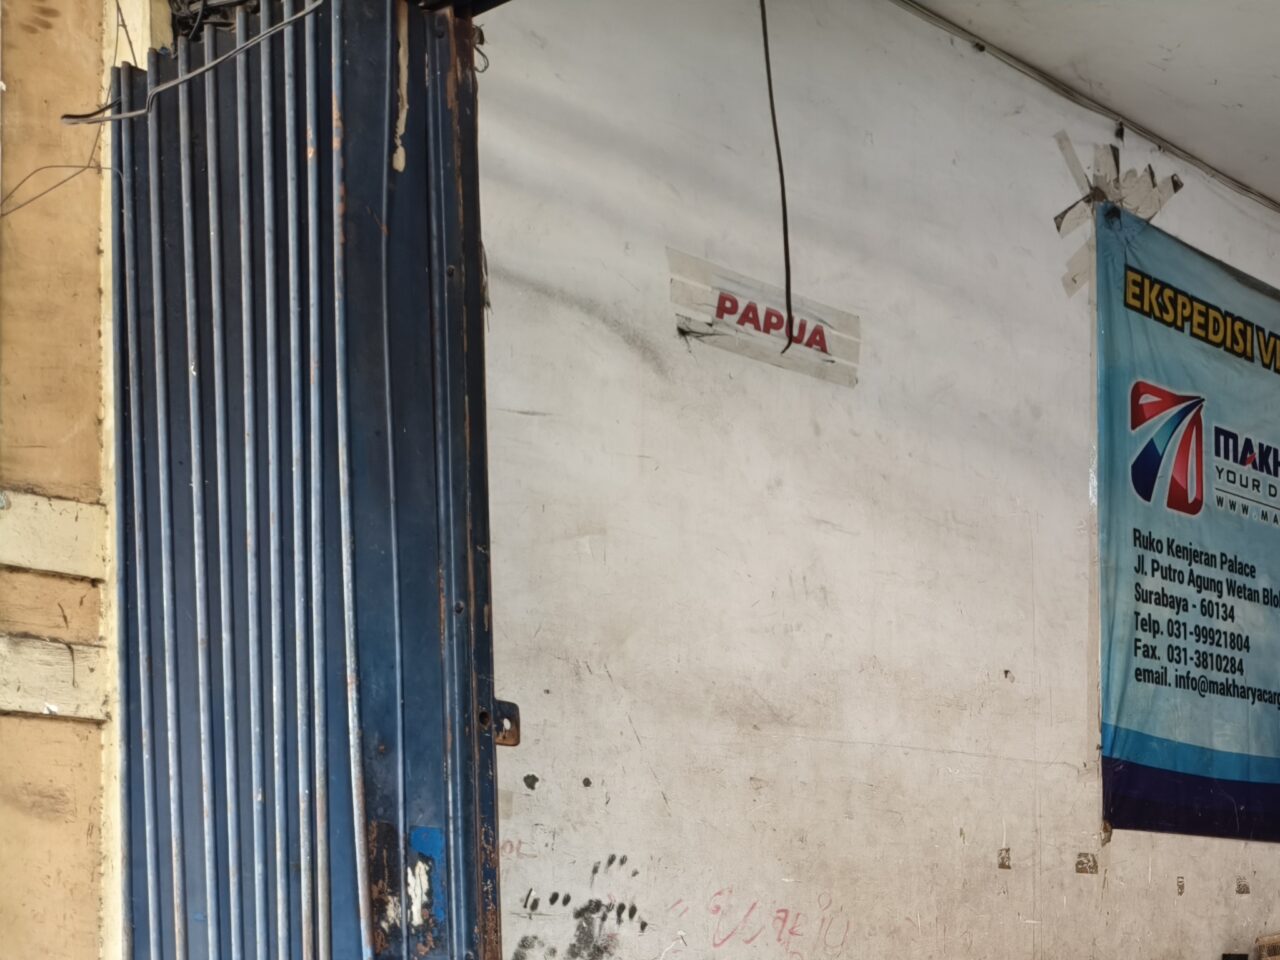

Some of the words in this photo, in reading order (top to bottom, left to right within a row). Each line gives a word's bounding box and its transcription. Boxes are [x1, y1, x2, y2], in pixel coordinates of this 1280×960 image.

[715, 291, 829, 354] PAPUA
[1124, 265, 1254, 362] EKSPEDISI
[1215, 465, 1261, 494] YOUR
[1133, 528, 1164, 555] Ruko
[1166, 537, 1218, 568] Kenjeran
[1219, 551, 1257, 579] Palace
[1133, 555, 1148, 576] Jl.
[1151, 559, 1185, 585] Putro
[1187, 569, 1223, 599] Agung
[1225, 578, 1260, 604] Wetan
[1134, 582, 1189, 616] Surabaya
[1200, 598, 1235, 623] 60134
[1134, 611, 1164, 639] Telp.
[1166, 618, 1250, 653] 031-99921804
[1133, 638, 1161, 661] Fax.
[1166, 644, 1244, 676] 031-3810284
[1134, 666, 1172, 687] email.
